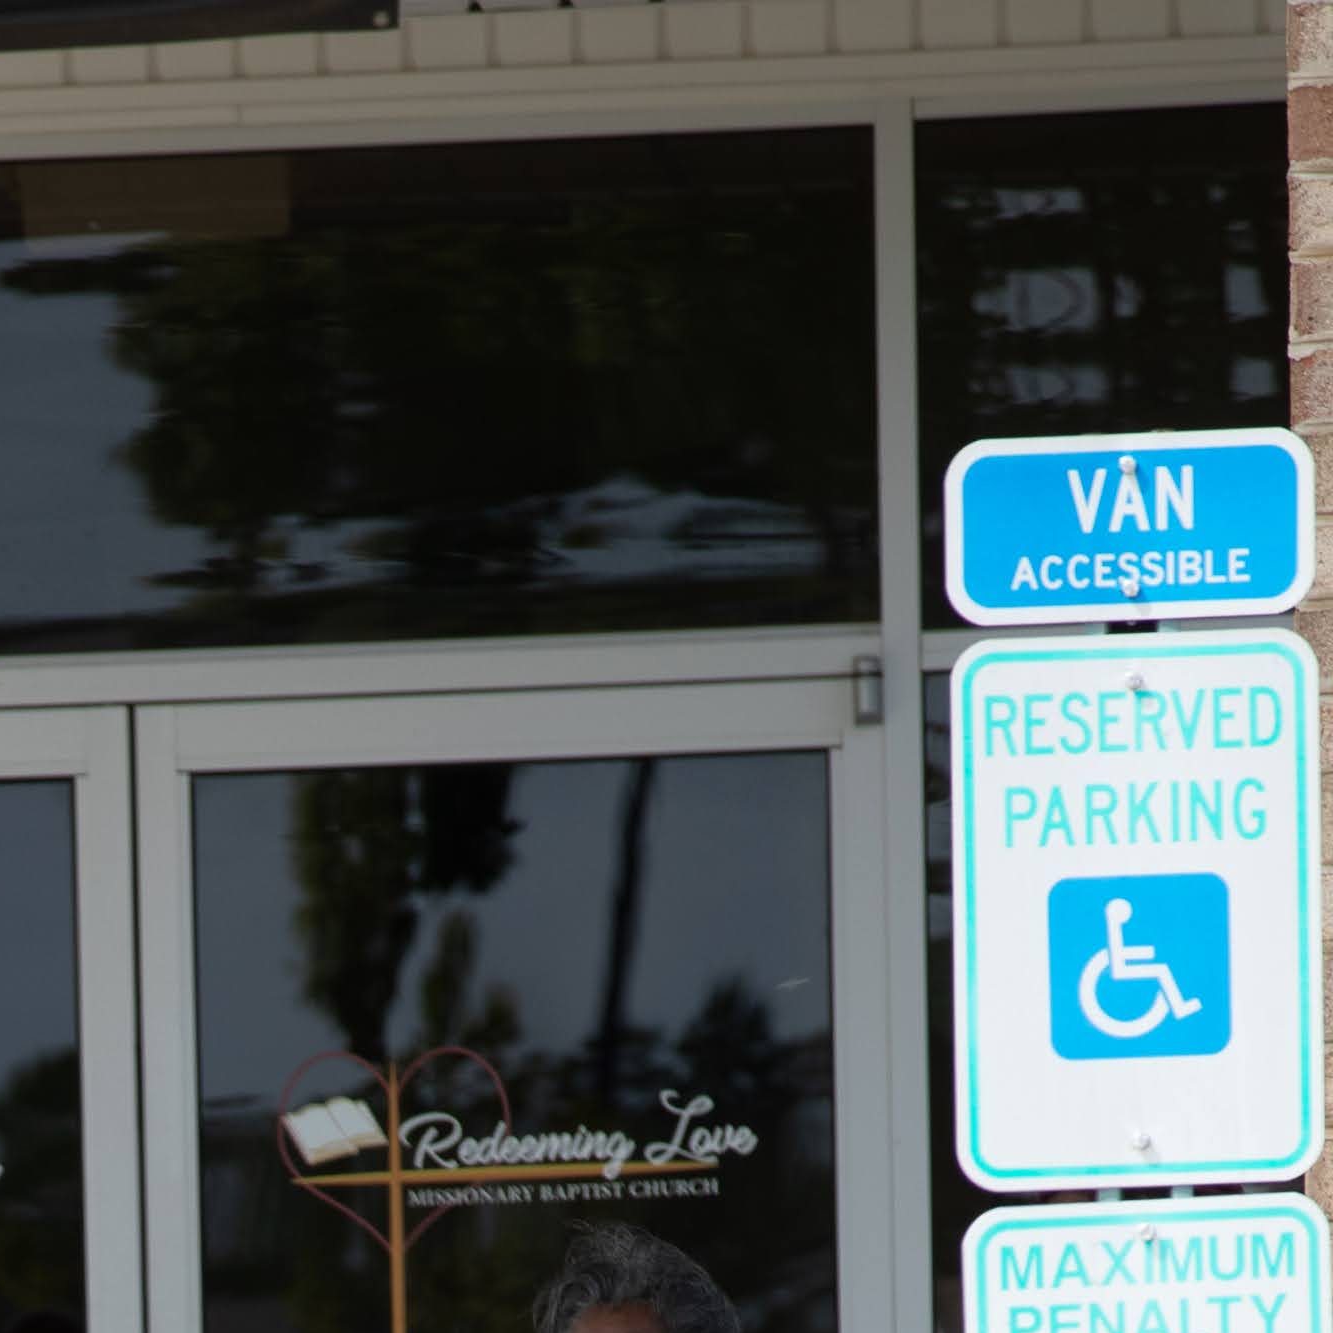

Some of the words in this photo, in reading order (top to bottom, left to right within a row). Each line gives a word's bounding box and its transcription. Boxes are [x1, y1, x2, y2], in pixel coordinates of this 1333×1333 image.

[1067, 464, 1194, 533] VAN
[1010, 548, 1251, 591] ACCESSIBLE
[984, 686, 1282, 757] RESERVED
[1004, 777, 1265, 848] PARKING
[398, 1112, 635, 1181] Redeeming
[644, 1089, 757, 1165] Love
[407, 1186, 533, 1208] MISSIONARY
[539, 1182, 624, 1203] BAPTIST
[629, 1177, 719, 1198] CHURCH
[999, 1231, 1295, 1291] MAXIMUM
